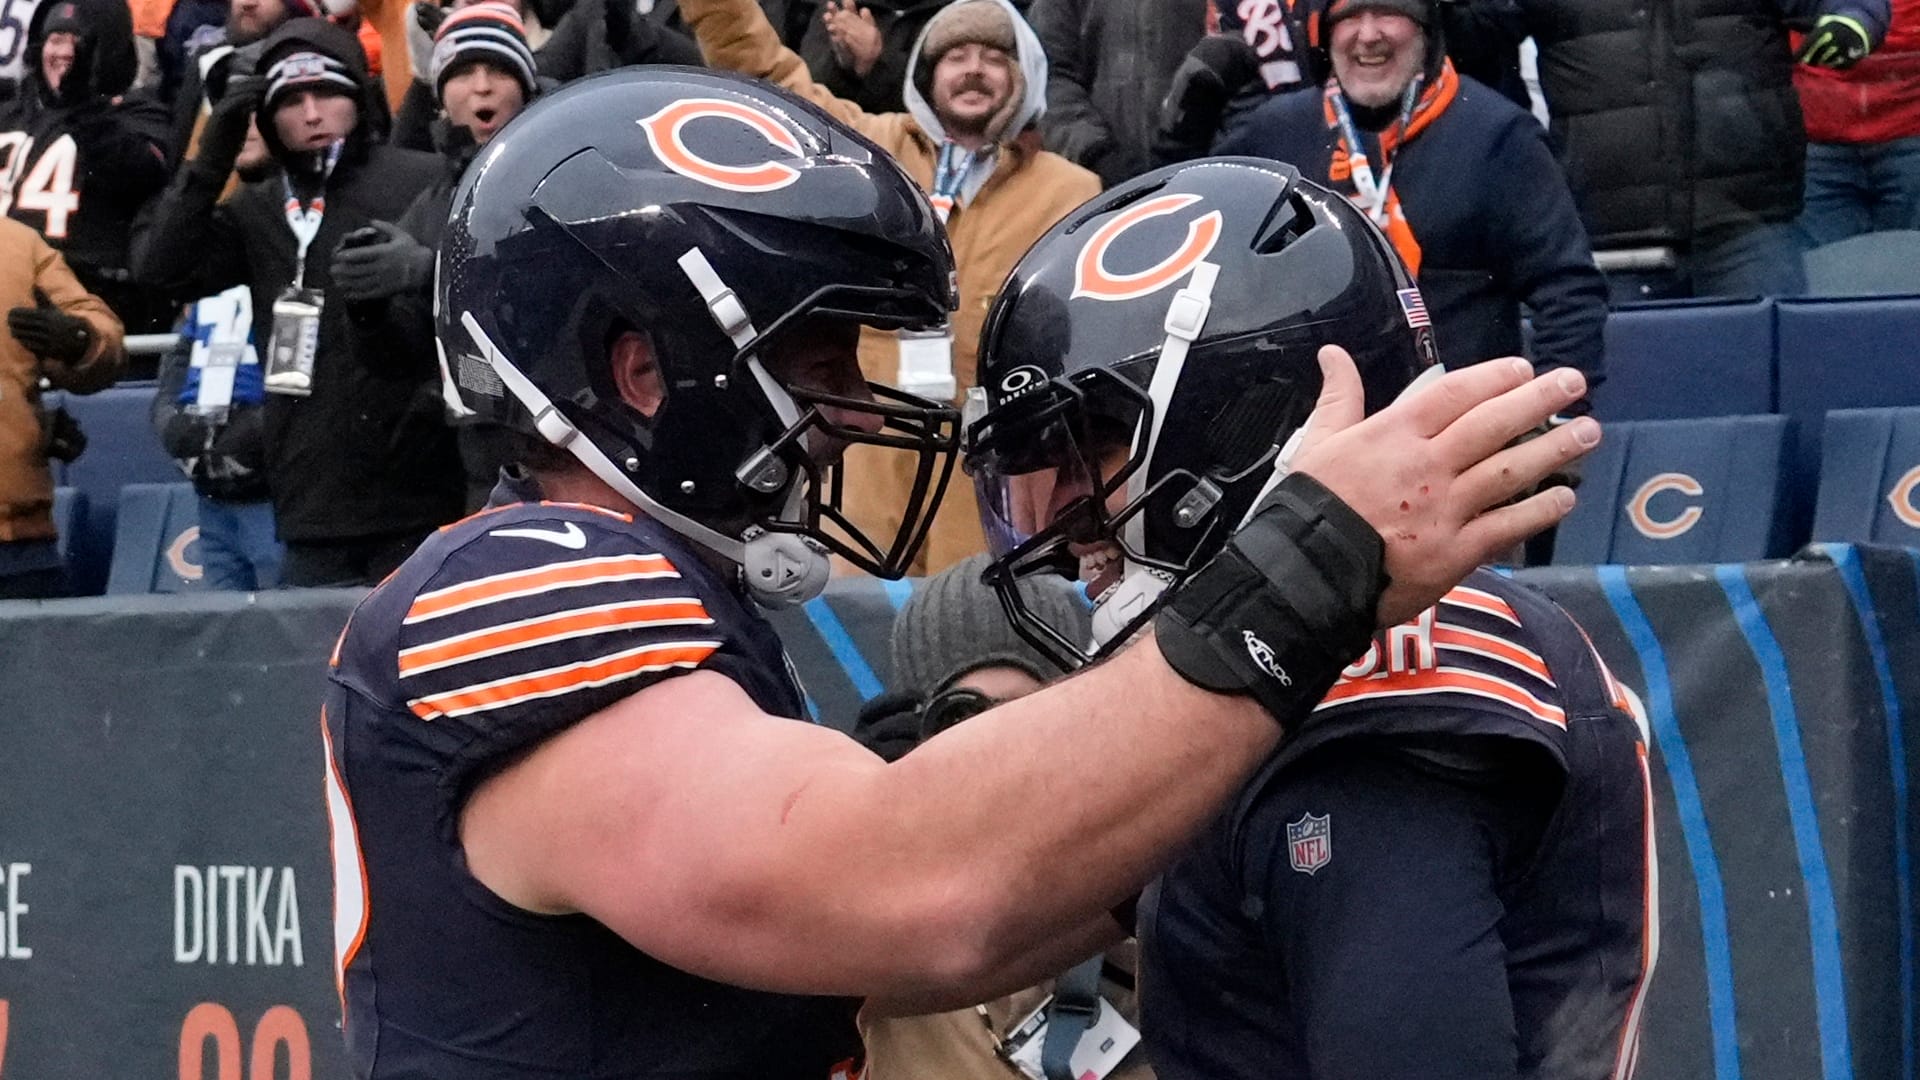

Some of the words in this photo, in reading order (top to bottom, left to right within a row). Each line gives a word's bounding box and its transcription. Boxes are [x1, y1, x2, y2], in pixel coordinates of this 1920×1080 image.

[1295, 839, 1326, 865] NFL
[0, 862, 33, 960] E
[174, 864, 304, 967] DITKA
